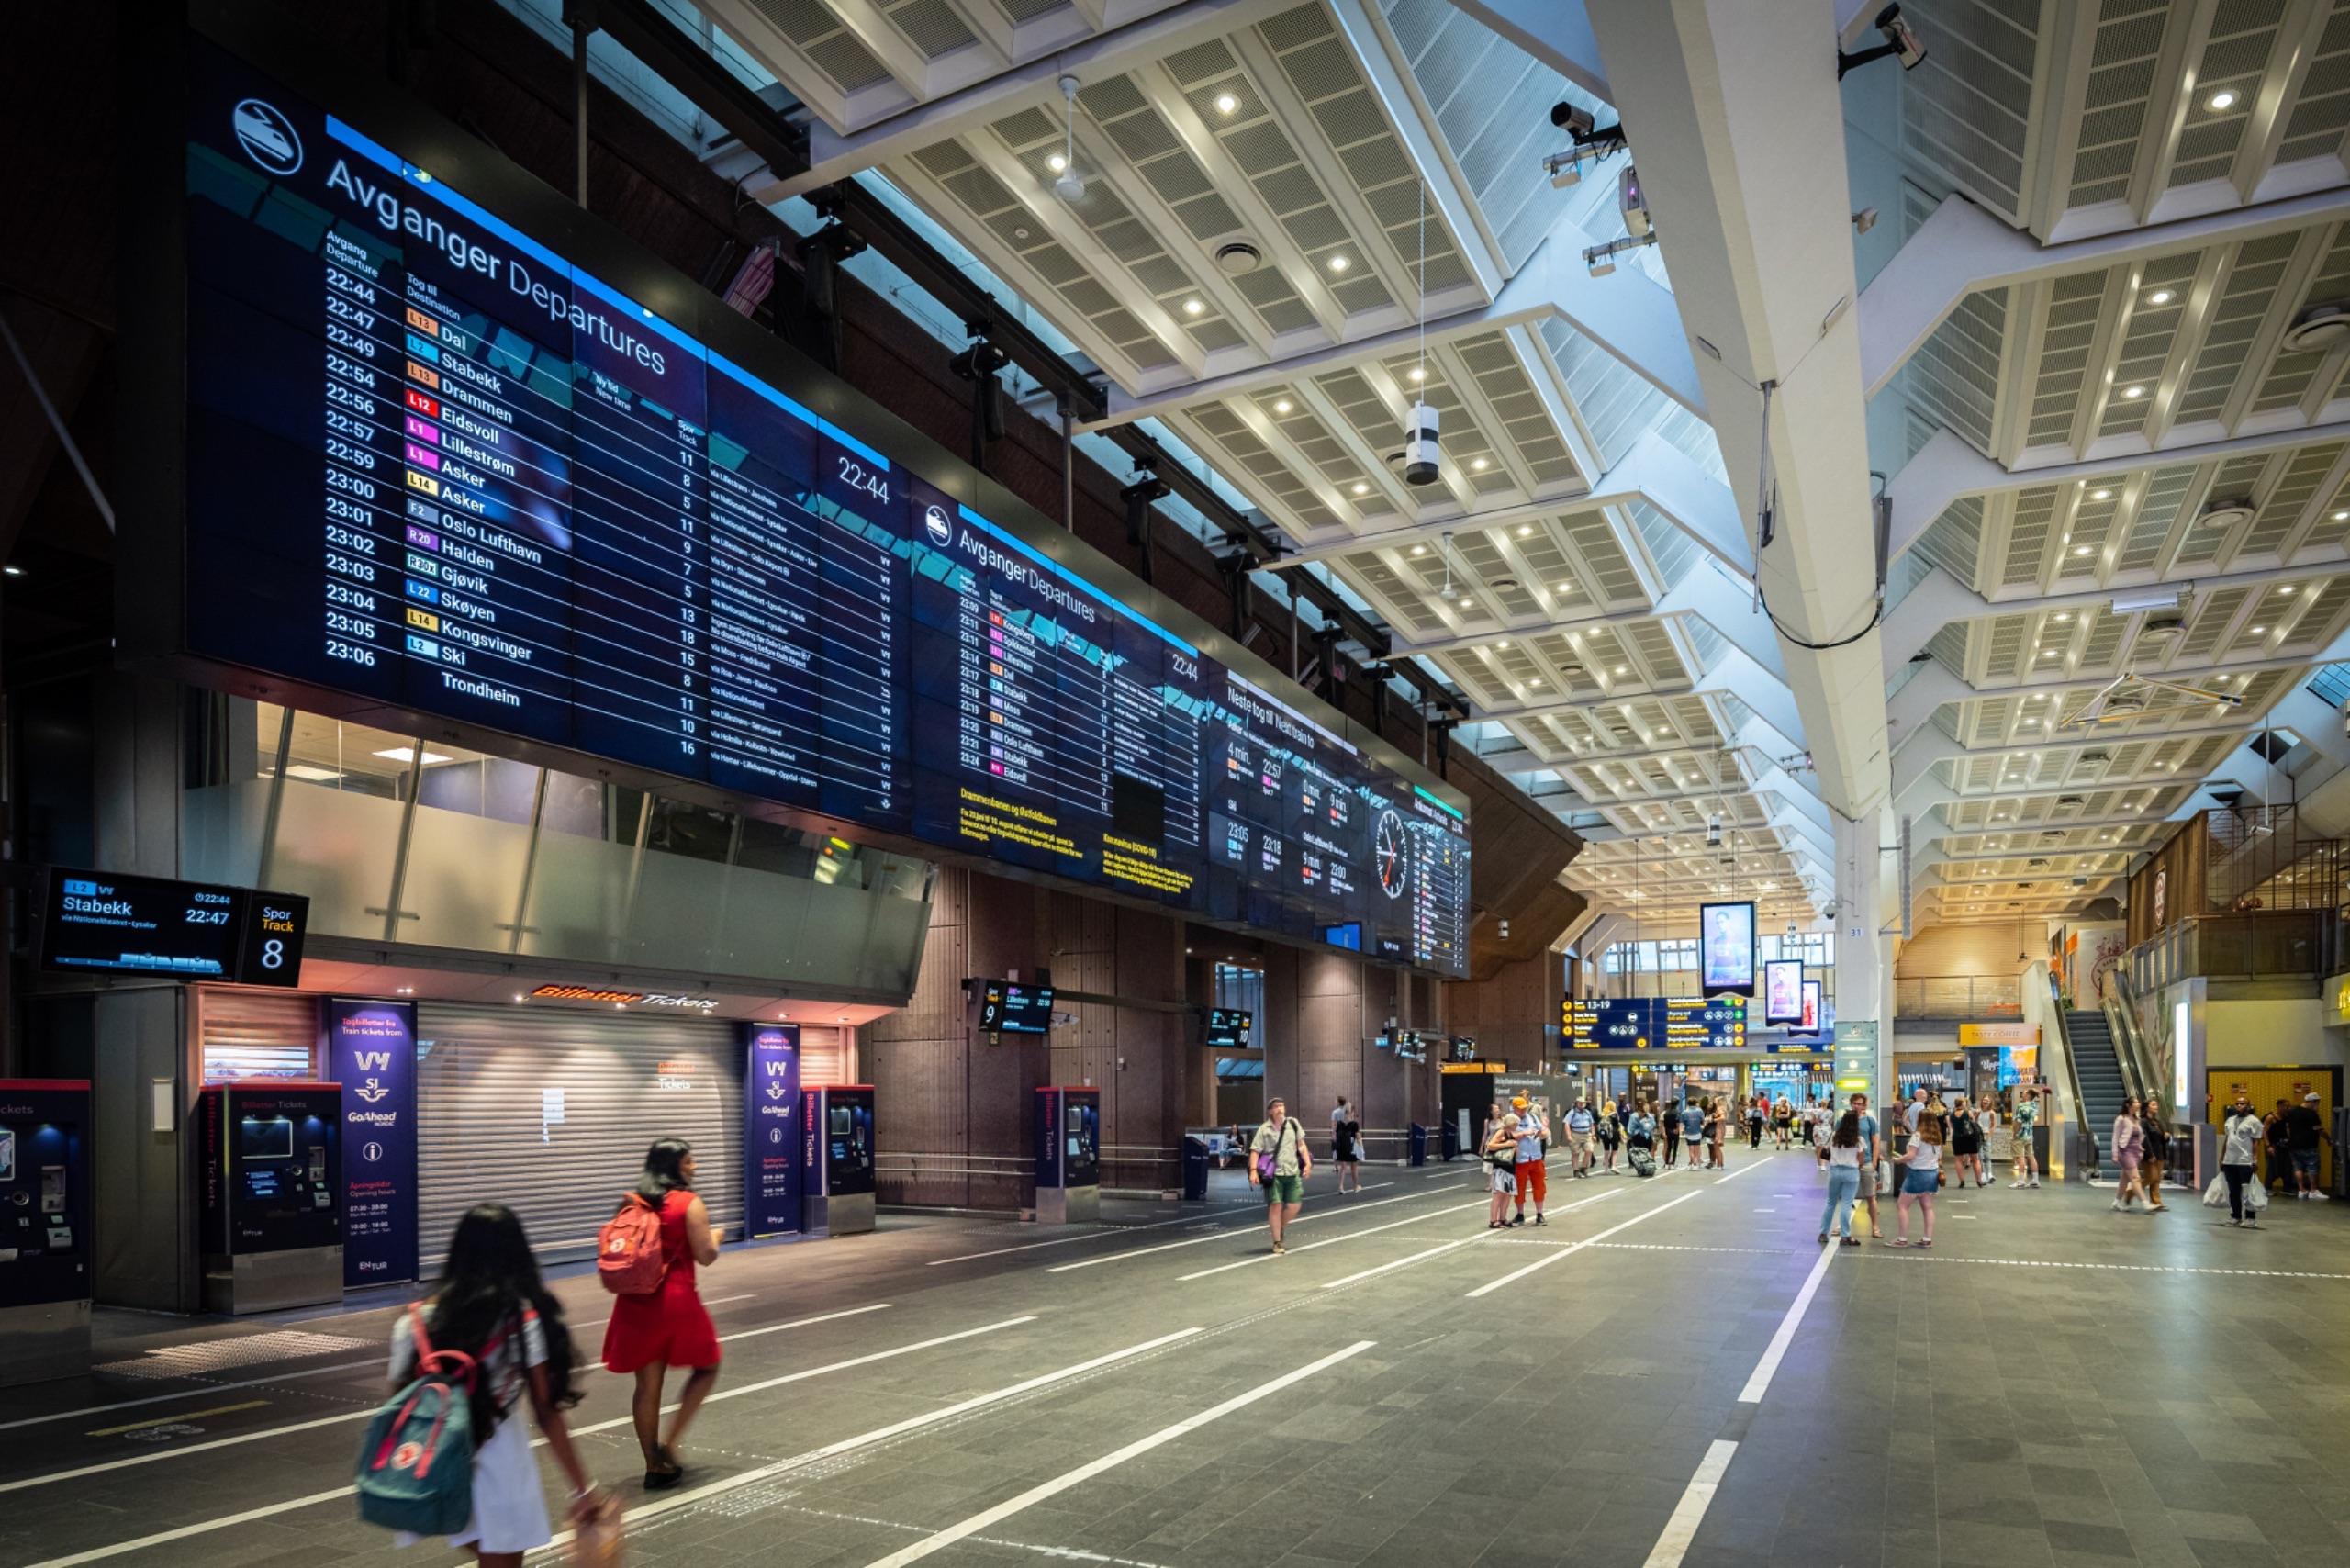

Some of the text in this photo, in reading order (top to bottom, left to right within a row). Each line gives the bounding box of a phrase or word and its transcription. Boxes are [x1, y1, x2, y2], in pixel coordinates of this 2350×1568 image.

[327, 230, 367, 261] Avgang
[326, 159, 665, 375] Avganger Departures
[327, 243, 378, 277] Departure
[326, 268, 375, 304] 22:44
[407, 273, 438, 297] Tog til
[326, 296, 375, 330] 22:47
[408, 286, 460, 320] Destination
[326, 324, 375, 358] 22:49
[442, 327, 466, 351] Dal
[326, 354, 375, 388] 22:54
[442, 353, 502, 394] Stabekk
[326, 383, 375, 415] 22:56
[442, 379, 513, 424] Drammen
[326, 411, 375, 442] 22:57
[442, 407, 499, 444] Eidsvoll
[678, 430, 698, 447] Track
[326, 440, 375, 469] 22:59
[442, 433, 515, 476] Lillestrøm
[680, 451, 693, 467] 11
[326, 469, 375, 499] 23:00
[442, 461, 485, 488] Asker
[683, 474, 691, 487] 8
[838, 456, 890, 505] 22:44
[326, 498, 373, 527] 23:01
[442, 487, 485, 514] Asker
[683, 496, 691, 510] 5
[680, 519, 693, 533] 11
[326, 526, 375, 555] 23:02
[442, 515, 476, 539] Oslo
[480, 527, 542, 565] Lufthavn
[683, 542, 692, 554] 9
[326, 554, 375, 582] 23:03
[442, 540, 494, 571] Halden
[442, 567, 488, 596] Gjøvik
[684, 564, 692, 577] 7
[959, 529, 1027, 584] Avganger
[1029, 568, 1095, 623] Departures
[326, 584, 375, 611] 23:04
[684, 586, 692, 598] 5
[442, 593, 495, 623] Skøyen
[680, 608, 695, 623] 13
[326, 612, 375, 639] 23:05
[681, 630, 695, 644] 18
[326, 642, 375, 666] 23:06
[442, 622, 532, 661] Kongsvinger
[442, 647, 465, 666] Ski
[681, 653, 695, 666] 15
[1172, 653, 1199, 682] 22:44
[442, 672, 520, 707] Trondheim
[683, 674, 691, 688] 8
[681, 697, 694, 711] 11
[1227, 686, 1251, 713] Neste
[1252, 701, 1265, 724] tog
[1275, 713, 1292, 736] Next
[1292, 725, 1307, 745] train
[1307, 734, 1315, 749] to
[681, 719, 695, 734] 10
[681, 741, 695, 756] 16
[1227, 822, 1248, 843] 23:05
[62, 896, 132, 916] Stabekk
[185, 909, 229, 925] 22:47
[263, 906, 292, 921] Spor
[263, 919, 295, 933] Track
[1851, 928, 1862, 937] 31
[262, 938, 284, 969] 8
[532, 984, 719, 1008] Billetter Tickets
[1586, 1000, 1611, 1010] 13-19
[985, 1005, 995, 1023] 9
[341, 1026, 403, 1036] Train tickets from
[1993, 1029, 2020, 1037] COFFEE
[365, 1078, 379, 1090] SJ
[659, 1077, 690, 1090] Tickets
[278, 1101, 307, 1109] Tickets
[806, 1093, 815, 1167] Billetter Tickets
[1045, 1093, 1055, 1161] Billetter Tickets
[207, 1158, 218, 1208] Tickets
